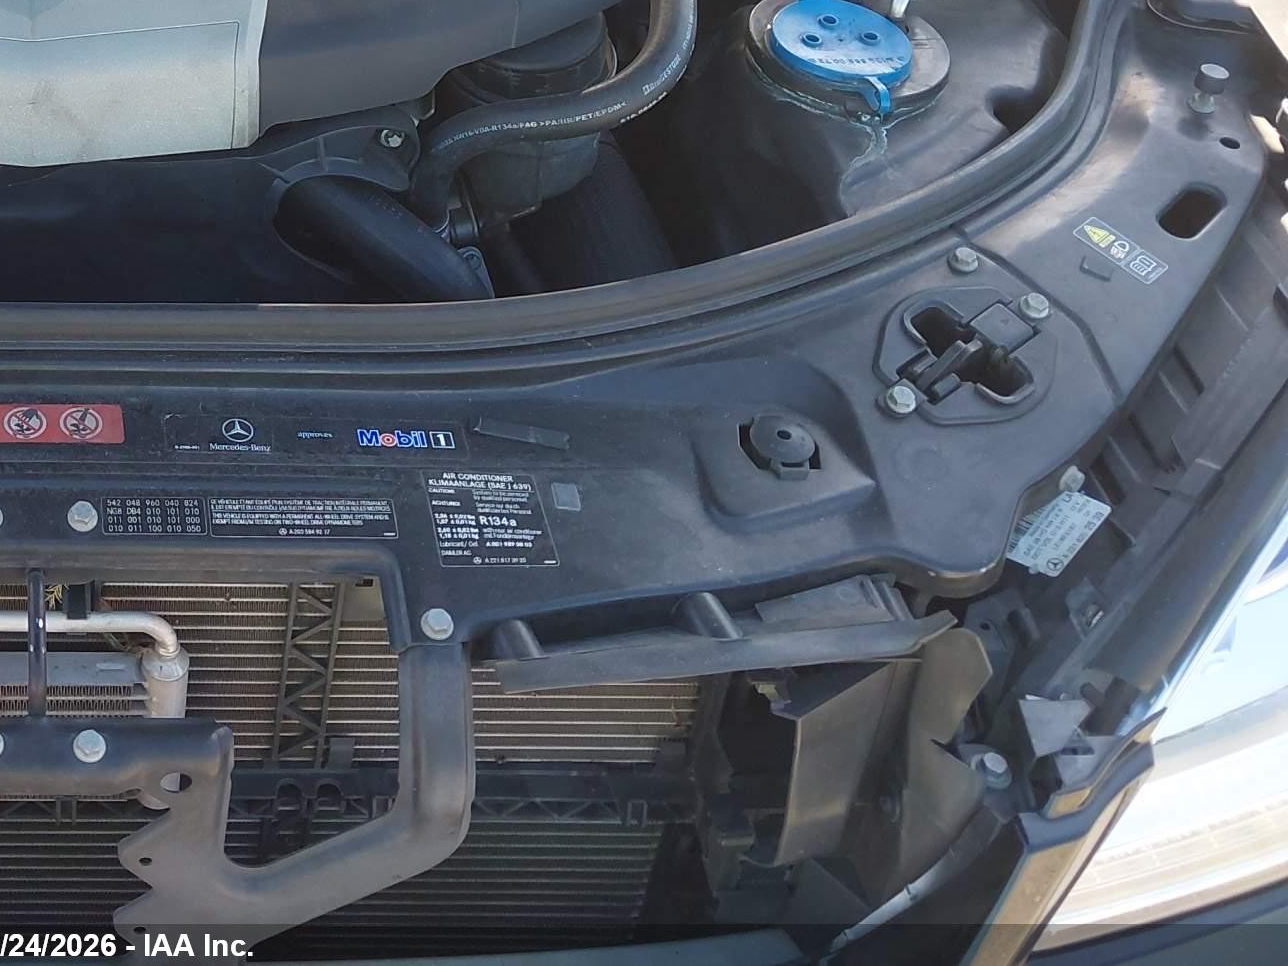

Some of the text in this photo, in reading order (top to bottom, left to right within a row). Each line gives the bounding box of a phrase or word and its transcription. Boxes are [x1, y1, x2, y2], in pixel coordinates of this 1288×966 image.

[297, 431, 333, 439] approves
[357, 429, 428, 448] Mobil
[209, 442, 272, 451] Mercedes-Benz
[458, 474, 514, 482] CONDITIONER
[428, 479, 486, 488] KLIMAANLAGE
[488, 482, 506, 490] (SAE
[108, 516, 200, 524] 011 001 010 101 000
[479, 515, 518, 526] R134a
